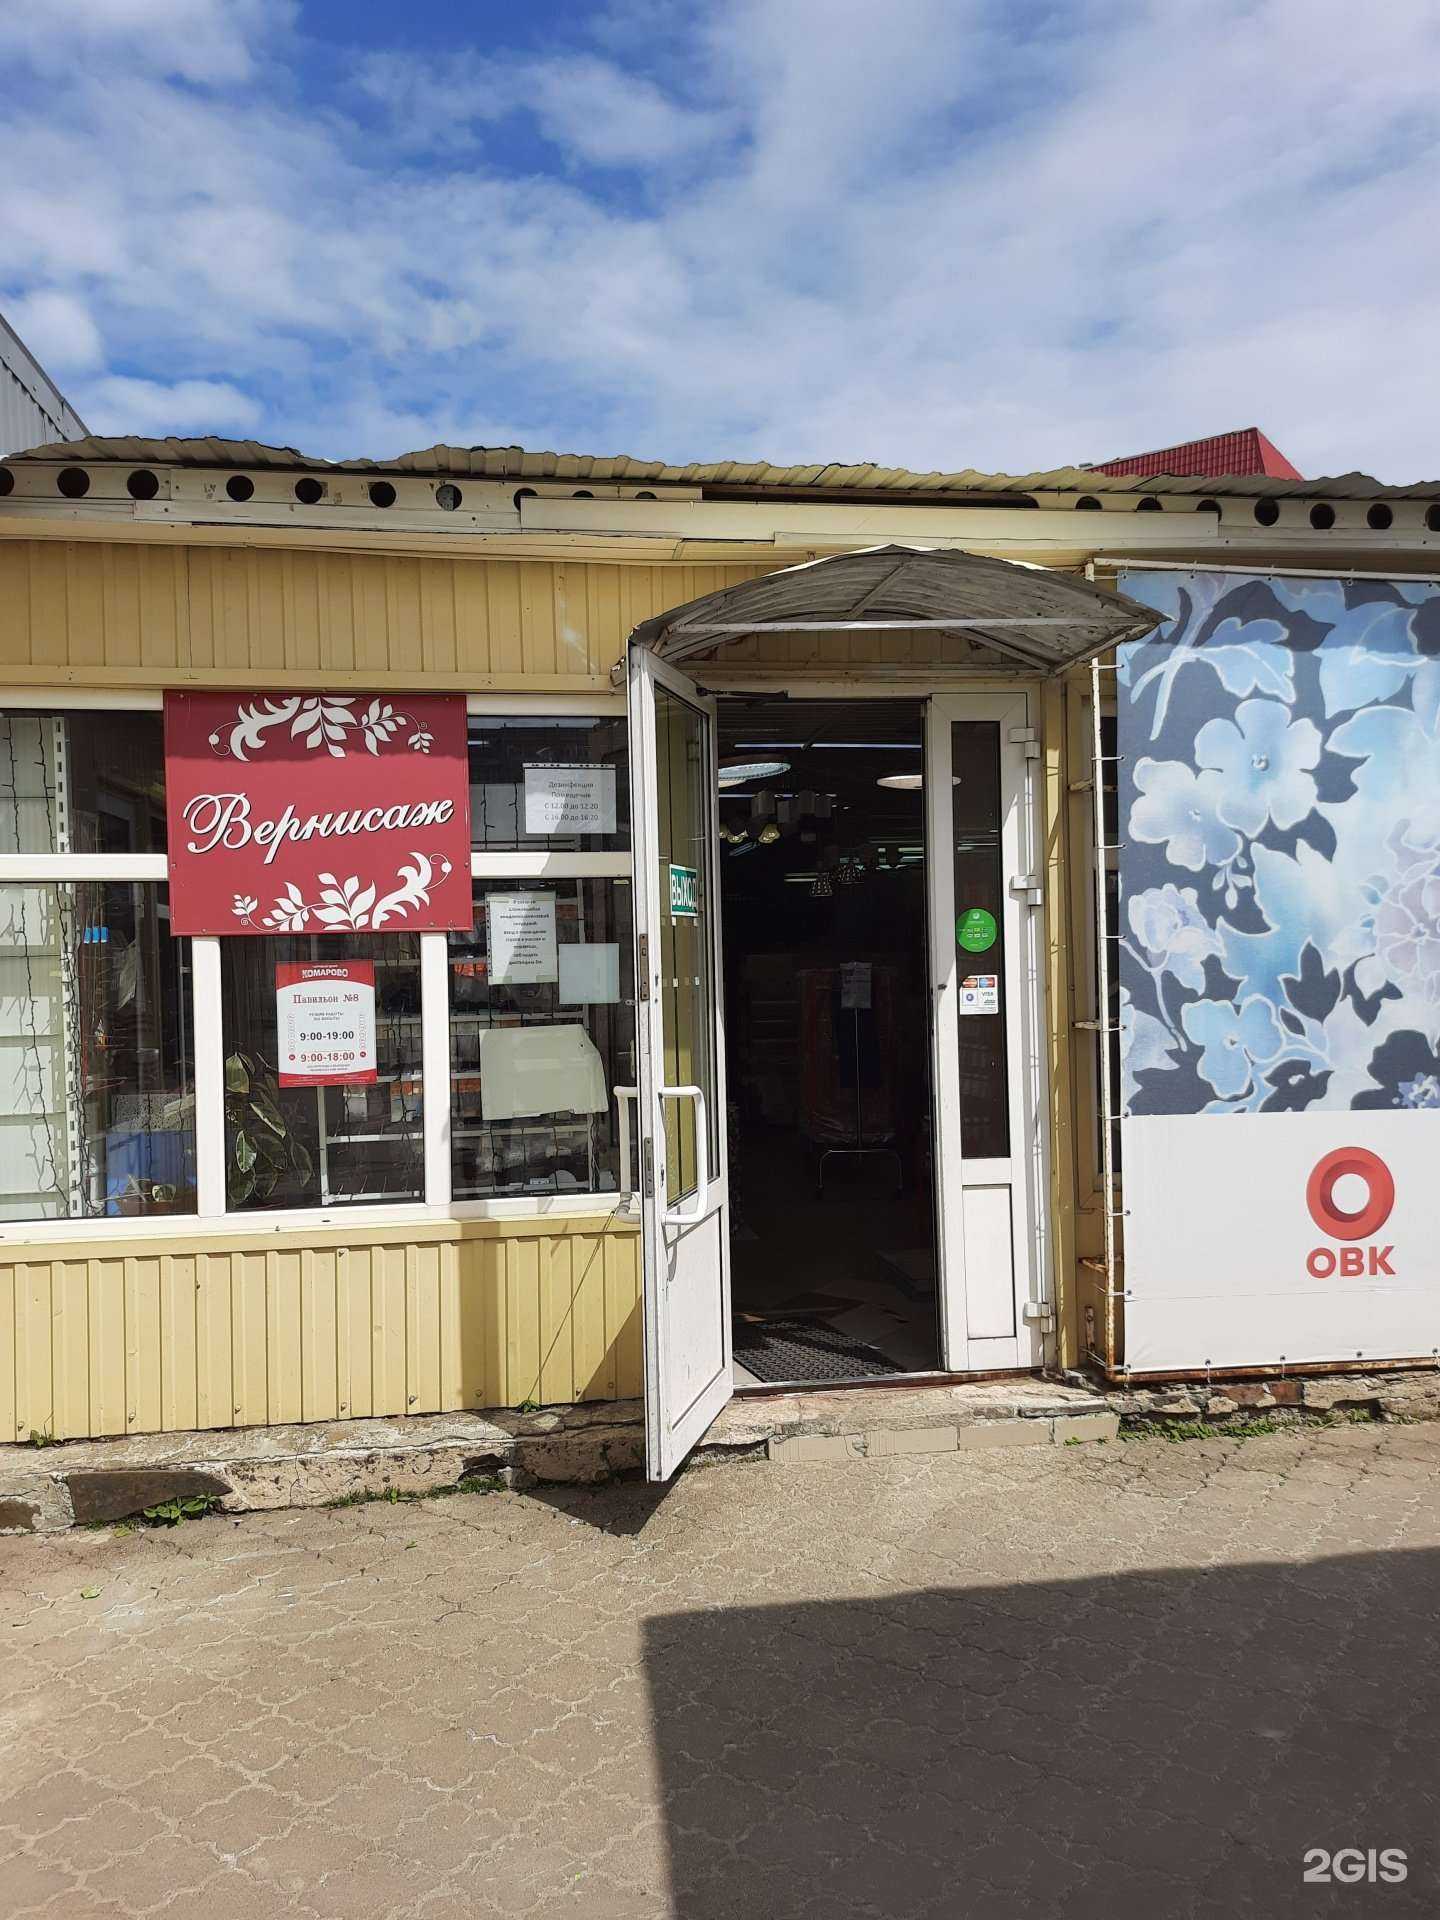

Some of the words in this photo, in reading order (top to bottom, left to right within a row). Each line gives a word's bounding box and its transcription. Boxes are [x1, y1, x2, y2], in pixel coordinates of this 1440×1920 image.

[182, 792, 454, 866] Вернисаж
[302, 968, 349, 979] КОМАРОВО
[293, 994, 339, 1004] Павильон
[342, 993, 359, 1003] №8
[300, 1030, 355, 1041] 9:00-19:00
[300, 1051, 355, 1062] 9:00-18:00
